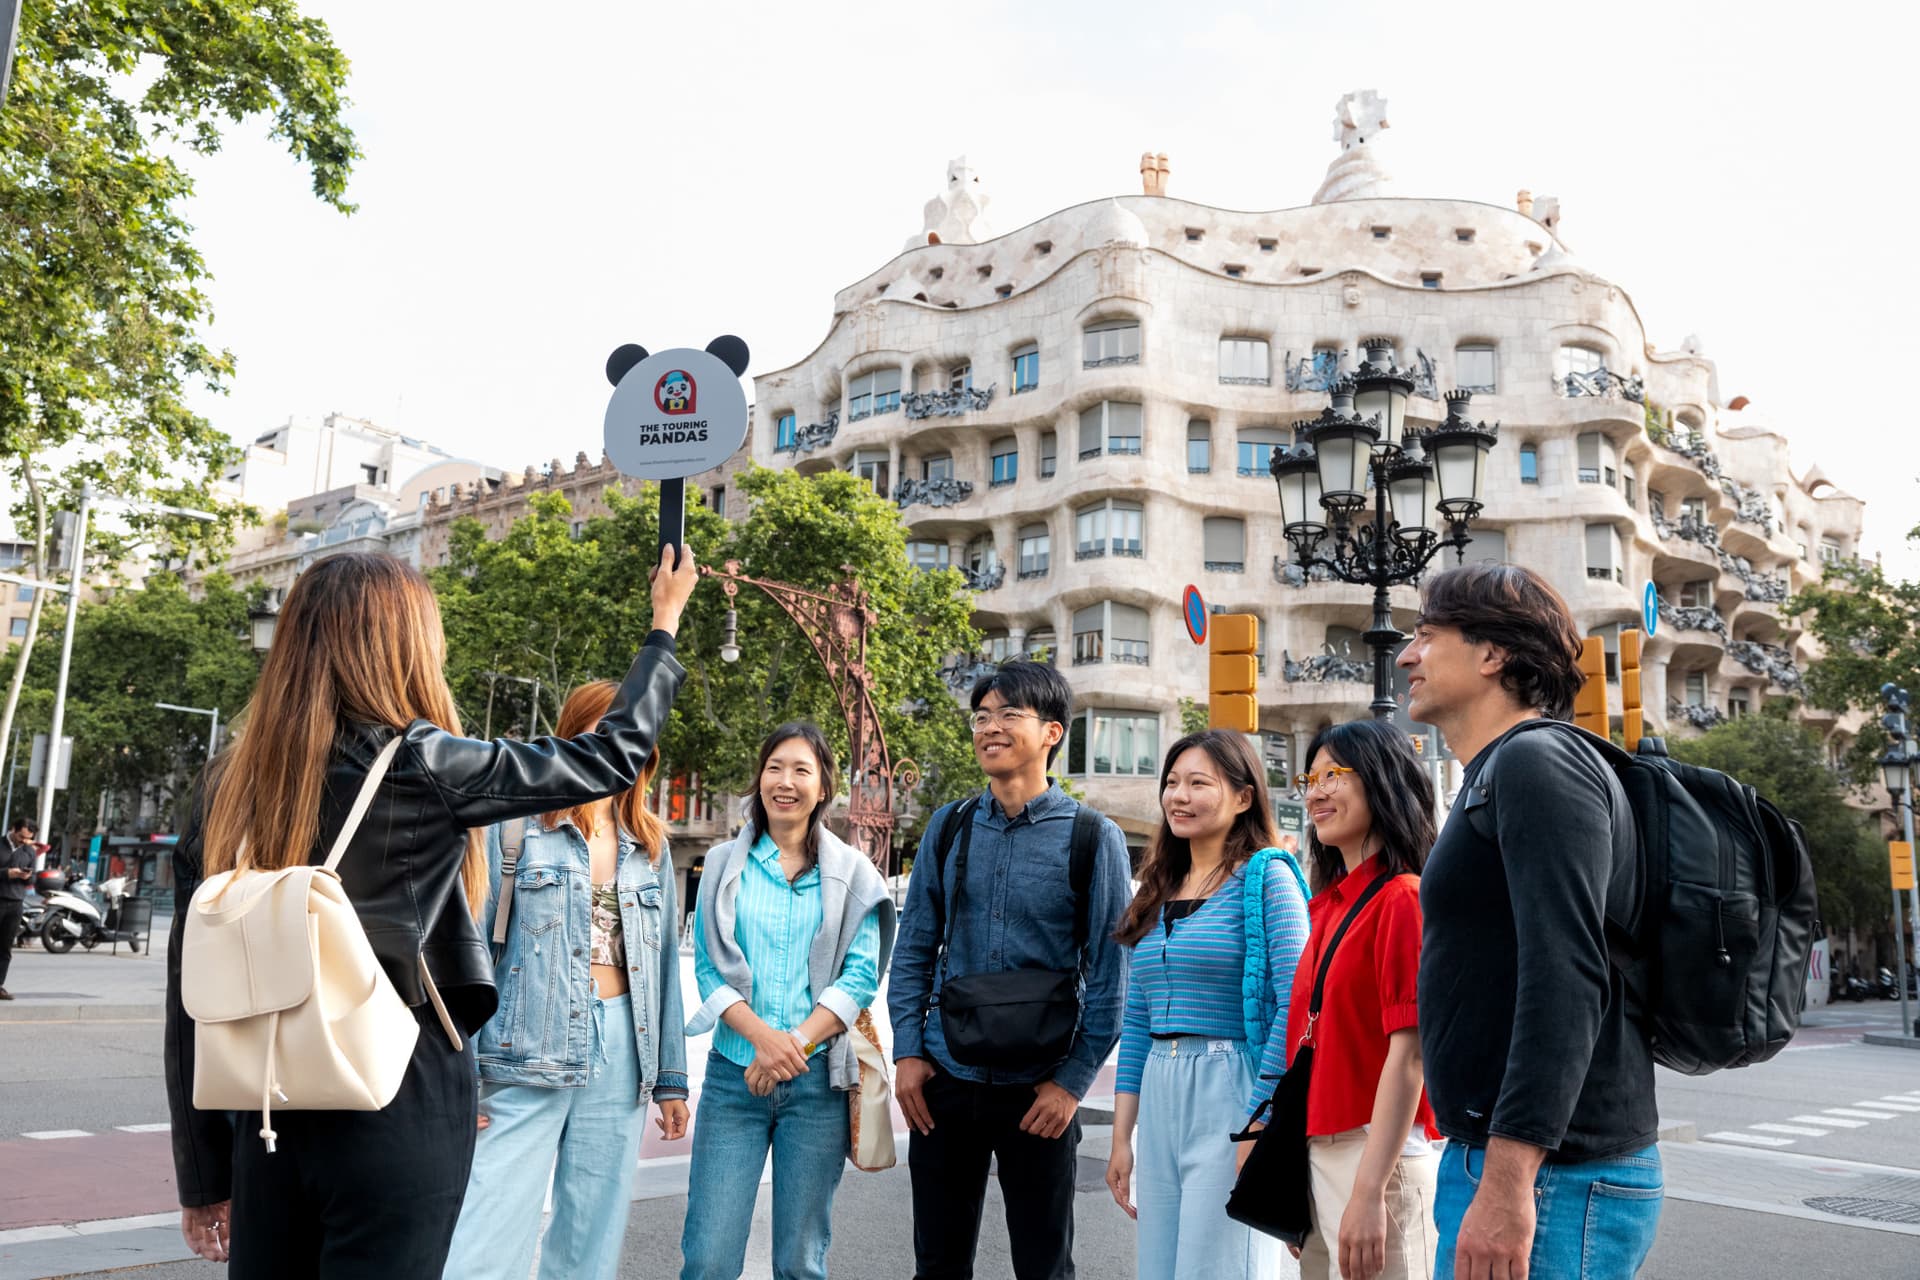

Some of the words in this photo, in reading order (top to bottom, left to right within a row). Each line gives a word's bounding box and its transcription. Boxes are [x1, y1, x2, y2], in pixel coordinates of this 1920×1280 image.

[640, 424, 660, 433] THE
[662, 420, 708, 431] TOURING
[640, 429, 708, 446] PANDAS
